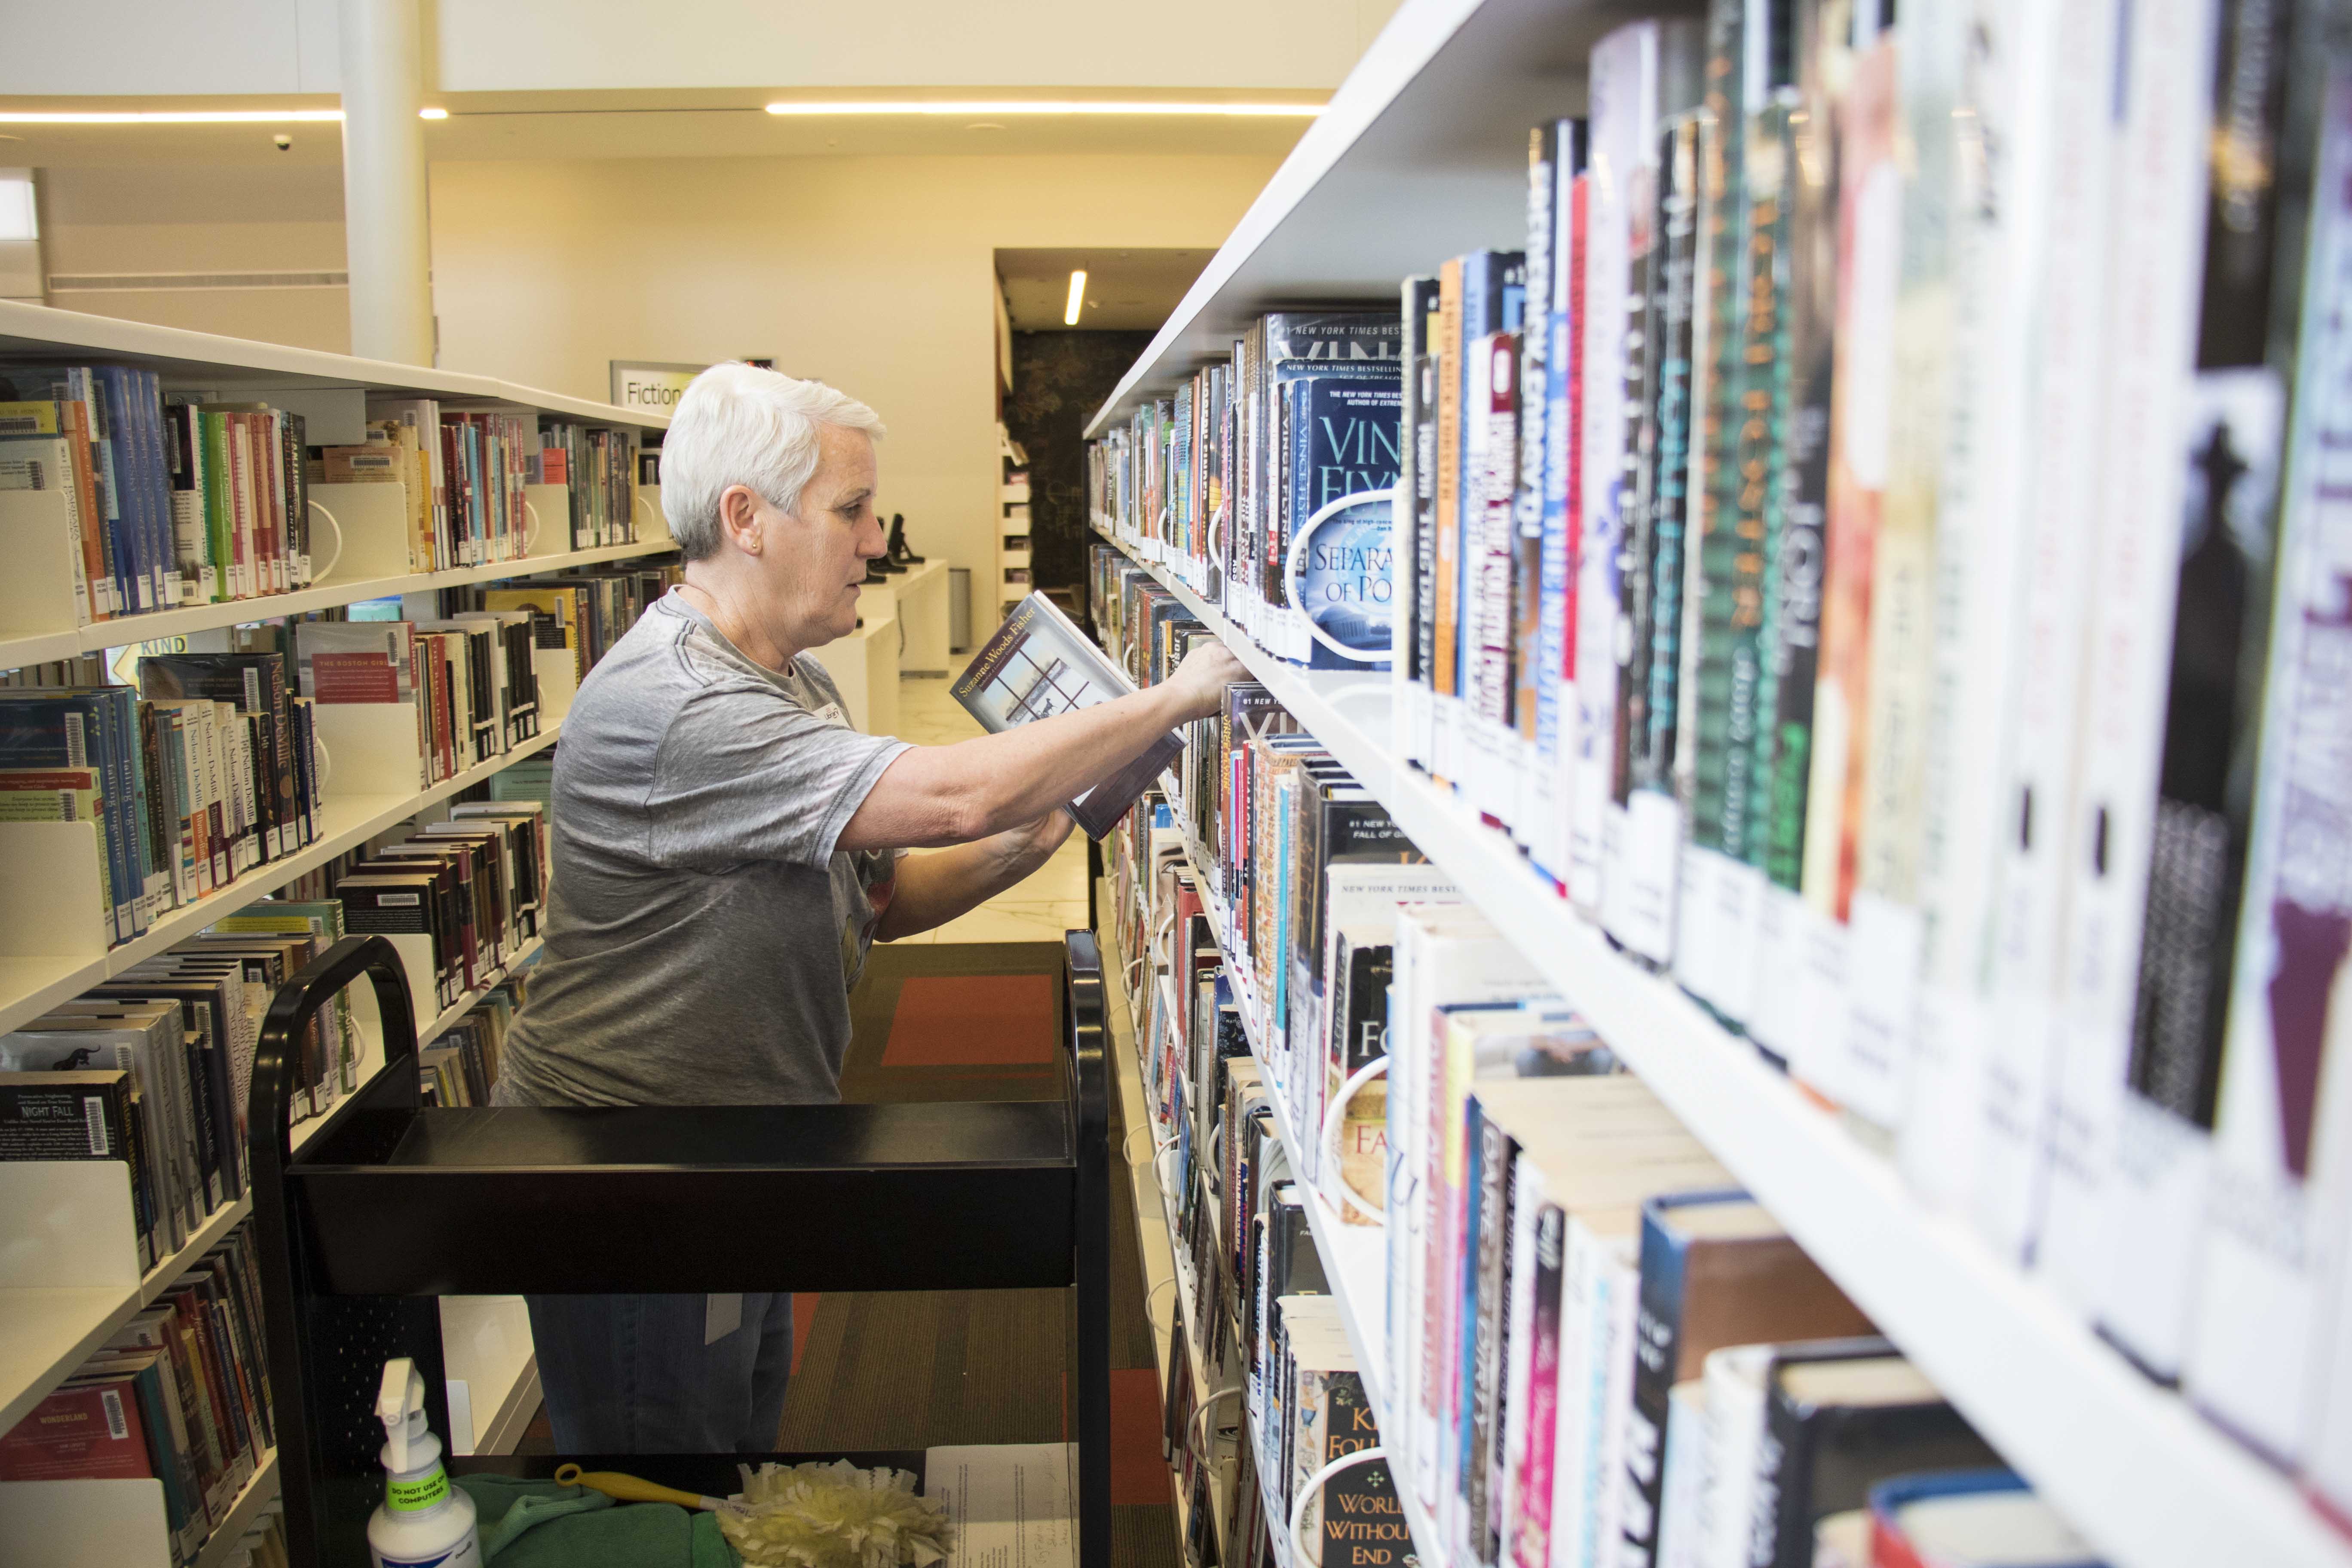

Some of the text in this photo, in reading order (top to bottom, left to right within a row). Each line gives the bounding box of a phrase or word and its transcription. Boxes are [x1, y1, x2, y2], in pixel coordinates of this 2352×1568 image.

[1295, 327, 1402, 335] NEW YORK TIMES BES
[627, 382, 682, 405] Fiction
[1298, 426, 1308, 478] VINCE
[220, 430, 232, 523] Barbara Delinsky
[1326, 583, 1351, 602] OF
[141, 637, 186, 655] KIND
[959, 607, 1035, 698] Suzanne Woods Fisher
[270, 660, 289, 769] Nelson DeMille
[190, 729, 201, 764] Nelson
[205, 721, 215, 757] Nelson
[208, 760, 217, 799] DeMille
[229, 747, 239, 781] Nelson
[193, 768, 204, 808] DeMille
[242, 755, 255, 824] Nelson DeMille
[106, 763, 123, 865] falling together
[123, 759, 139, 860] falling together
[196, 814, 205, 837] Rivers
[1161, 894, 1174, 906] A
[178, 1039, 194, 1133] Nelson DeMille
[199, 1080, 208, 1119] Nelson
[21, 1106, 74, 1118] NIGHT FALL
[121, 1093, 132, 1136] NELSON
[40, 1412, 88, 1424] WONDERLAND
[398, 1485, 444, 1504] COMPUTERS
[404, 1487, 421, 1495] NOT
[423, 1480, 438, 1491] USE
[1352, 1547, 1392, 1566] END
